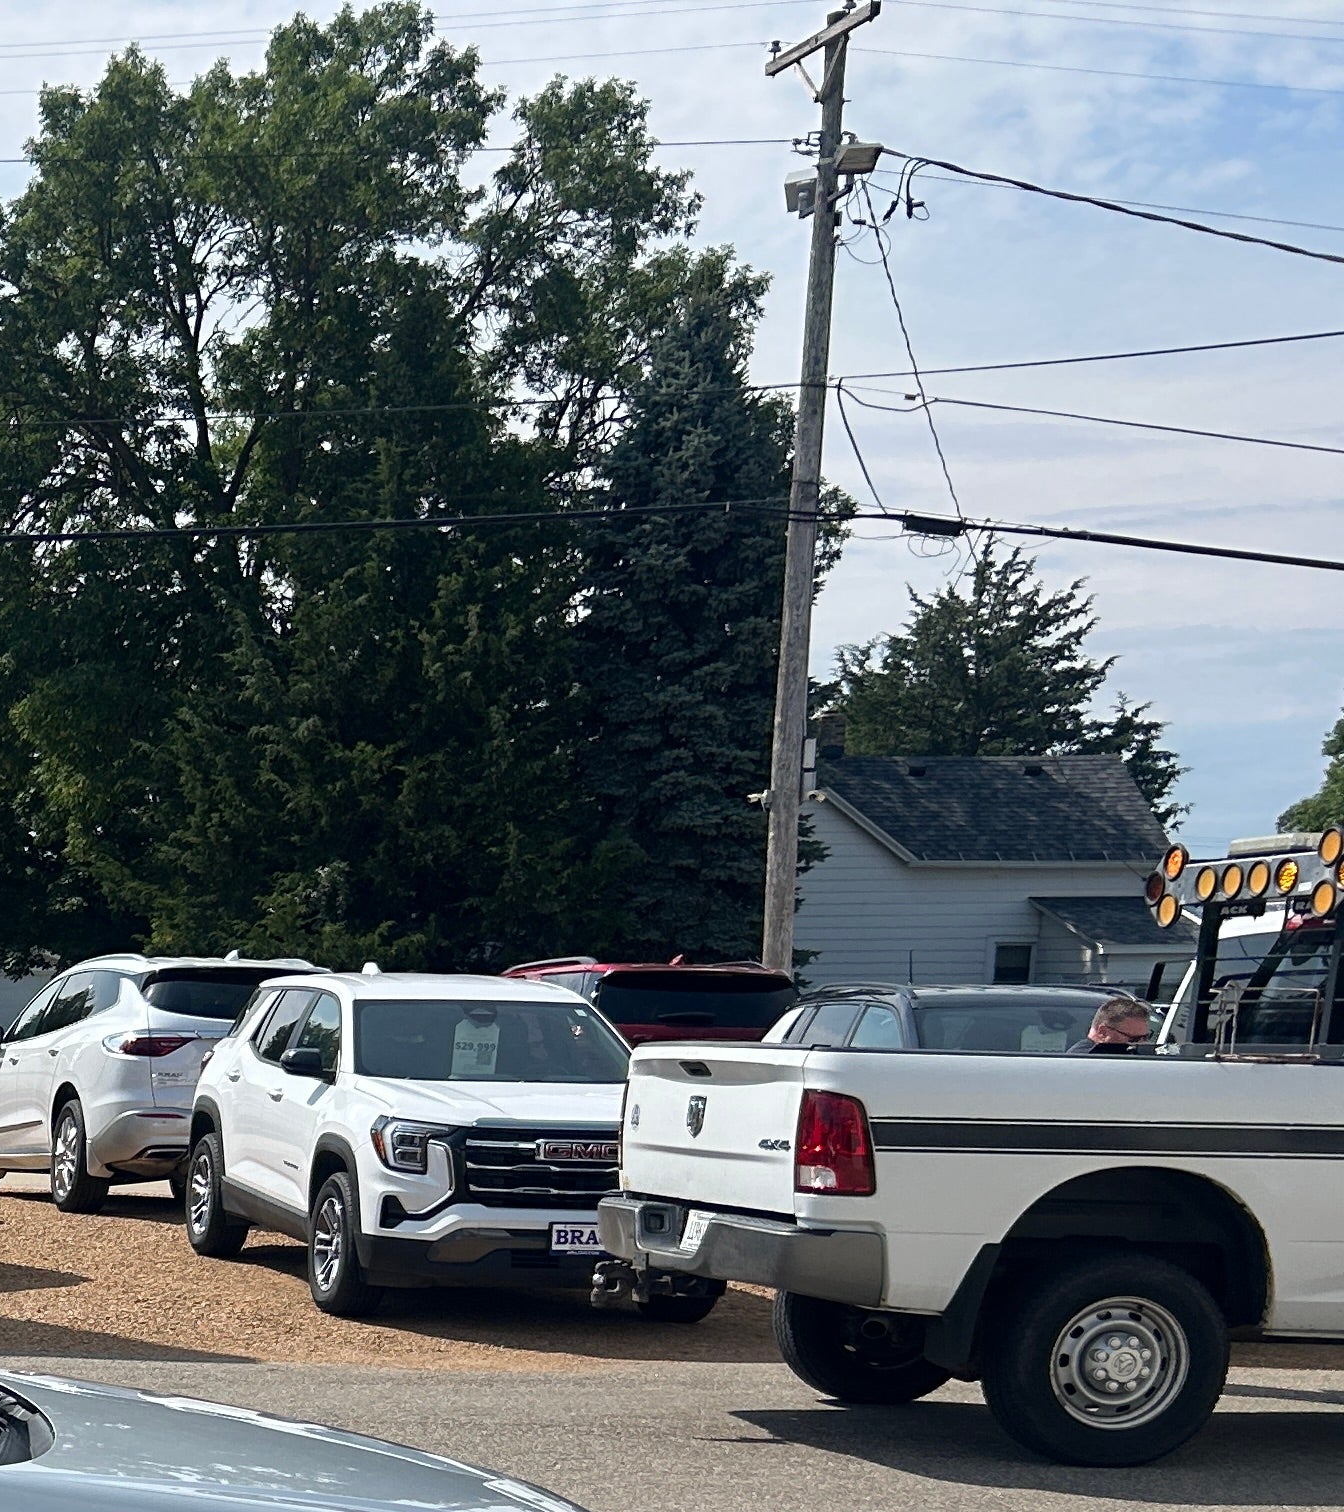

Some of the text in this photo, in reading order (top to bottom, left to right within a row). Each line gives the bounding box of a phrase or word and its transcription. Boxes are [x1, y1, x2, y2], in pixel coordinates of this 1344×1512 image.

[455, 1041, 497, 1052] $29,999
[545, 1142, 621, 1160] GMC
[553, 1229, 602, 1246] BRA
